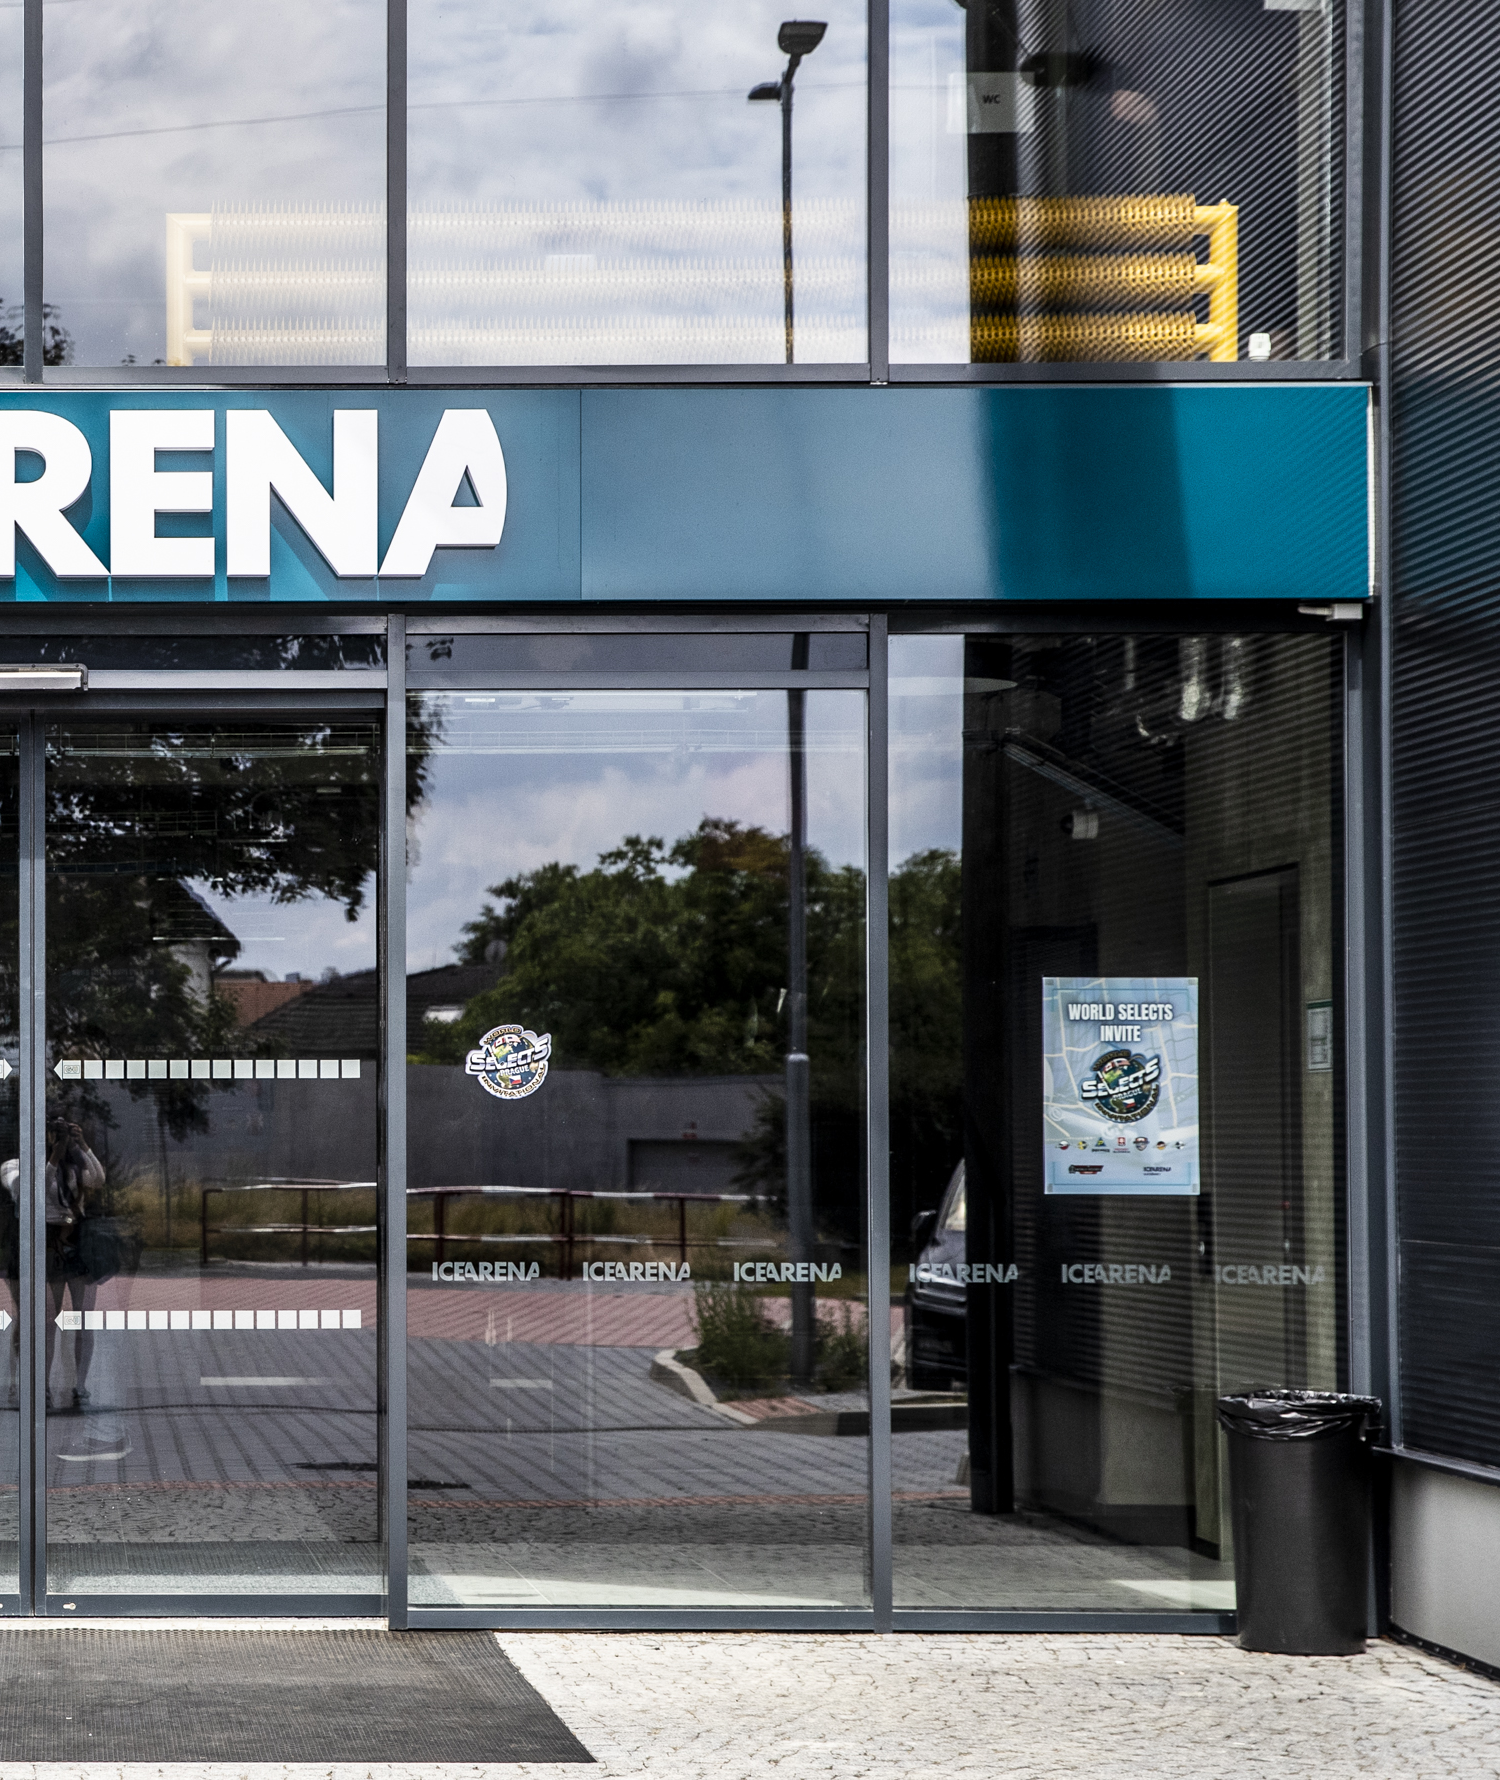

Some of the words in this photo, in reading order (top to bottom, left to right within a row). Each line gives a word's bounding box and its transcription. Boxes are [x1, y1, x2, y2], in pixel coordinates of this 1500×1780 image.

[983, 94, 1001, 104] WC
[1068, 1004, 1115, 1020] WORLD
[1118, 1004, 1173, 1020] SELECTS
[1100, 1025, 1141, 1042] INVITE
[499, 1065, 530, 1076] PRAGUE
[432, 1261, 540, 1281] ICEARENA
[583, 1261, 691, 1281] ICEARENA
[733, 1262, 842, 1282] ICEARENA
[909, 1263, 1019, 1283] ICEARENA
[1062, 1263, 1171, 1284] ICEARENA
[1215, 1264, 1325, 1285] ICEARENA
